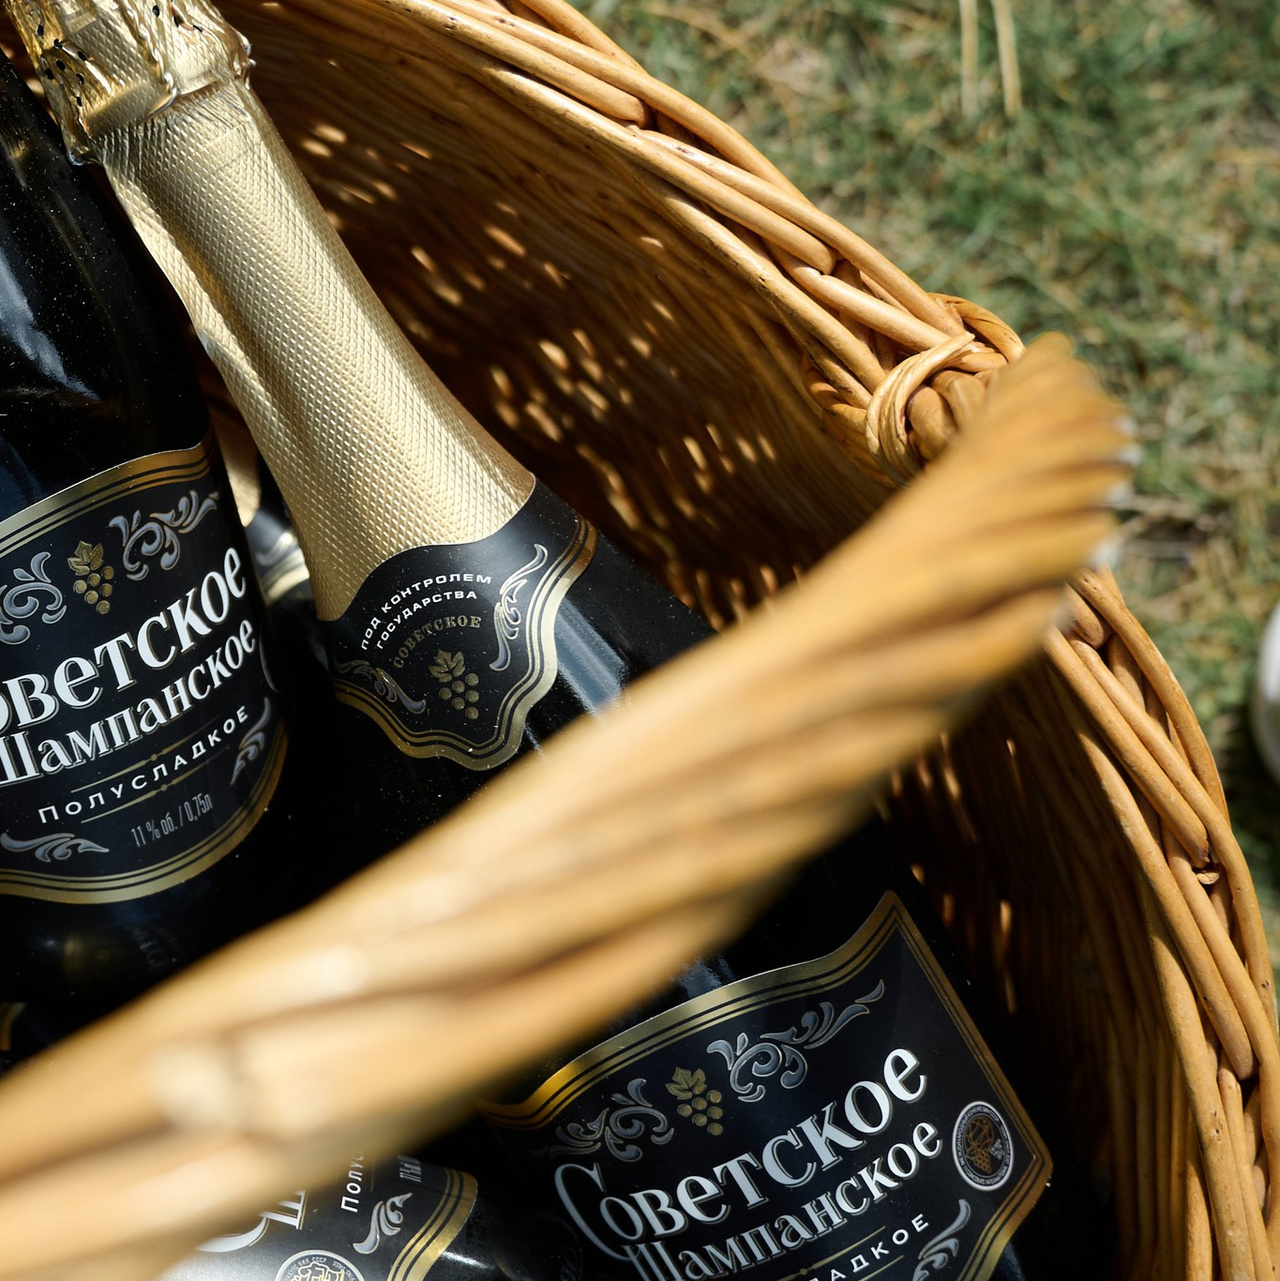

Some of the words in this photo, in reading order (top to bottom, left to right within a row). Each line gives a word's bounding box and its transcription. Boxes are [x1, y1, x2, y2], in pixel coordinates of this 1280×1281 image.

[360, 616, 382, 651] ПОД
[380, 573, 492, 614] КОНТРОЛЕМ
[376, 590, 478, 650] ГОСУДАРСТВА
[393, 615, 482, 669] СОВЕТСКОЕ
[38, 705, 249, 824] ПОЛУСЛАДКОЕ
[131, 825, 147, 848] 11
[146, 821, 161, 841] %
[160, 812, 179, 836] об.
[184, 792, 213, 823] 0,75л
[554, 1047, 927, 1261] Советское
